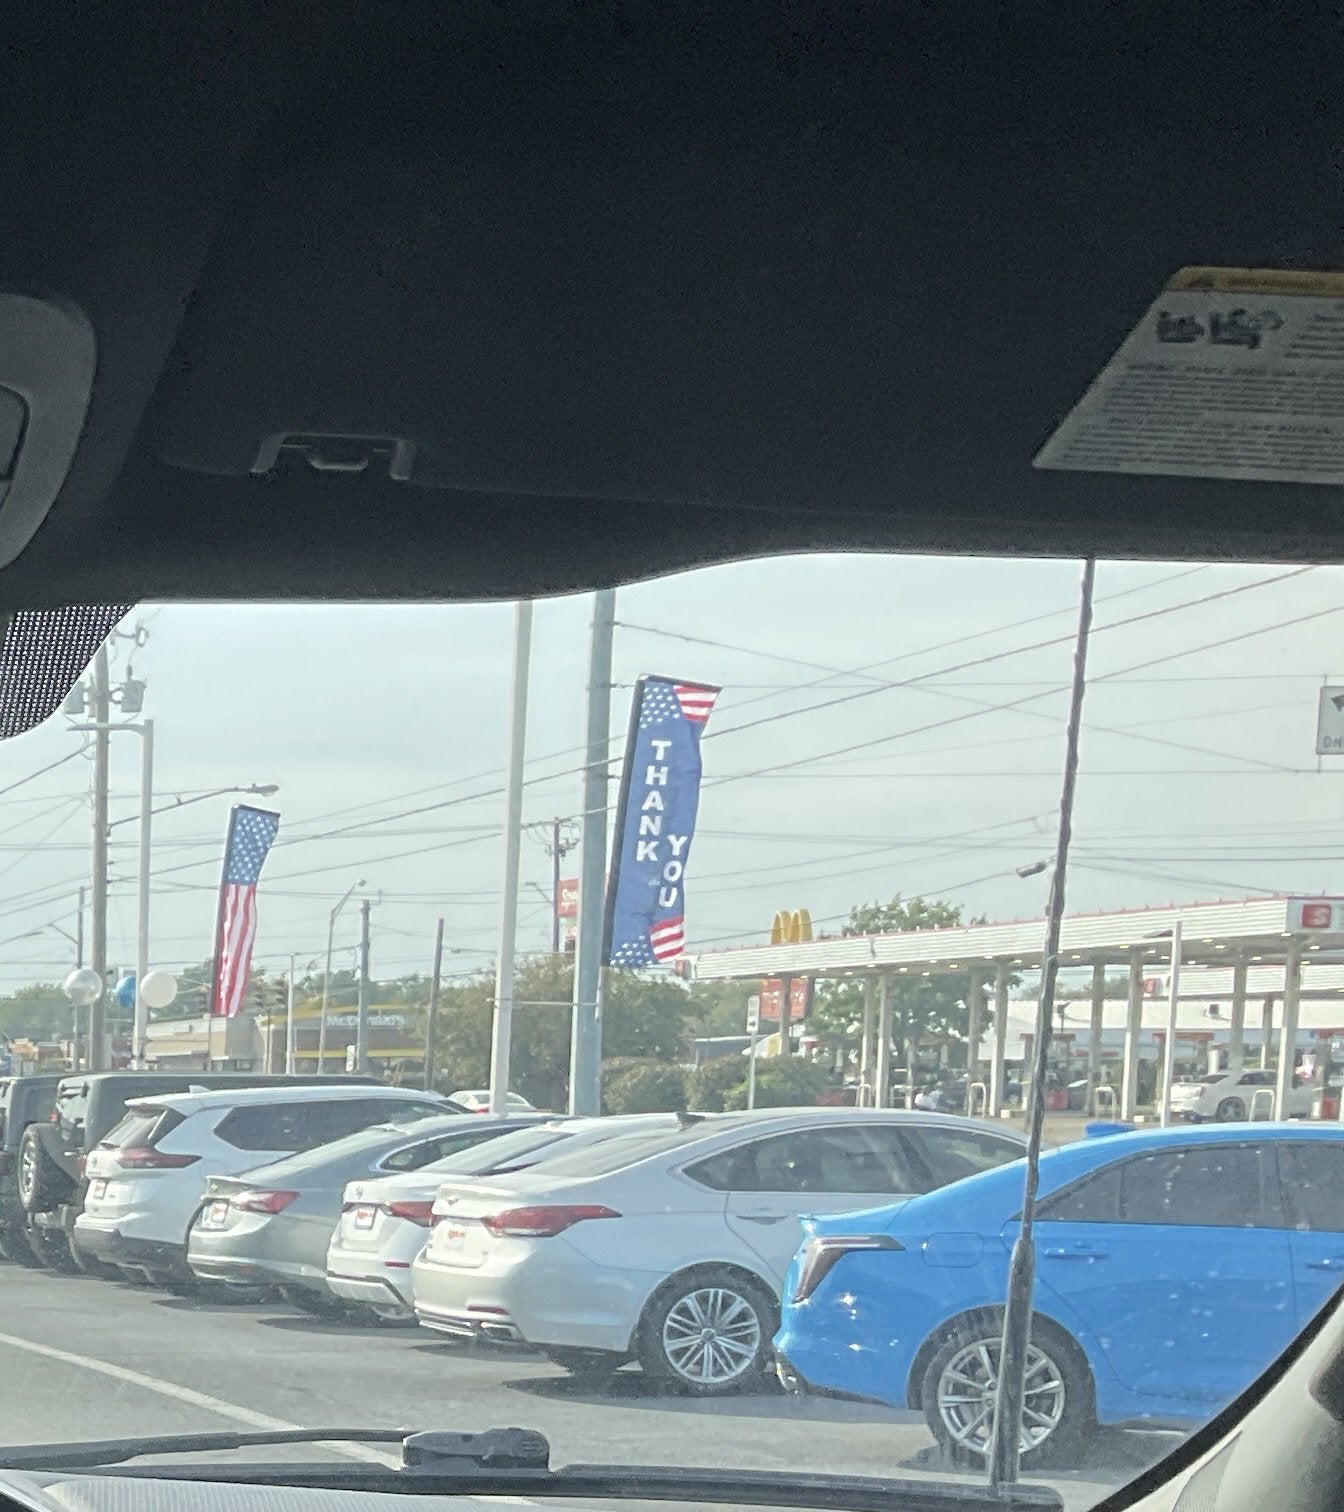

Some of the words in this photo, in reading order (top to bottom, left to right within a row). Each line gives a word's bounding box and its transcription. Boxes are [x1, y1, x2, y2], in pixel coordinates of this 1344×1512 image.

[1323, 735, 1344, 749] ON
[636, 739, 672, 861] THANK
[657, 834, 687, 908] YOU
